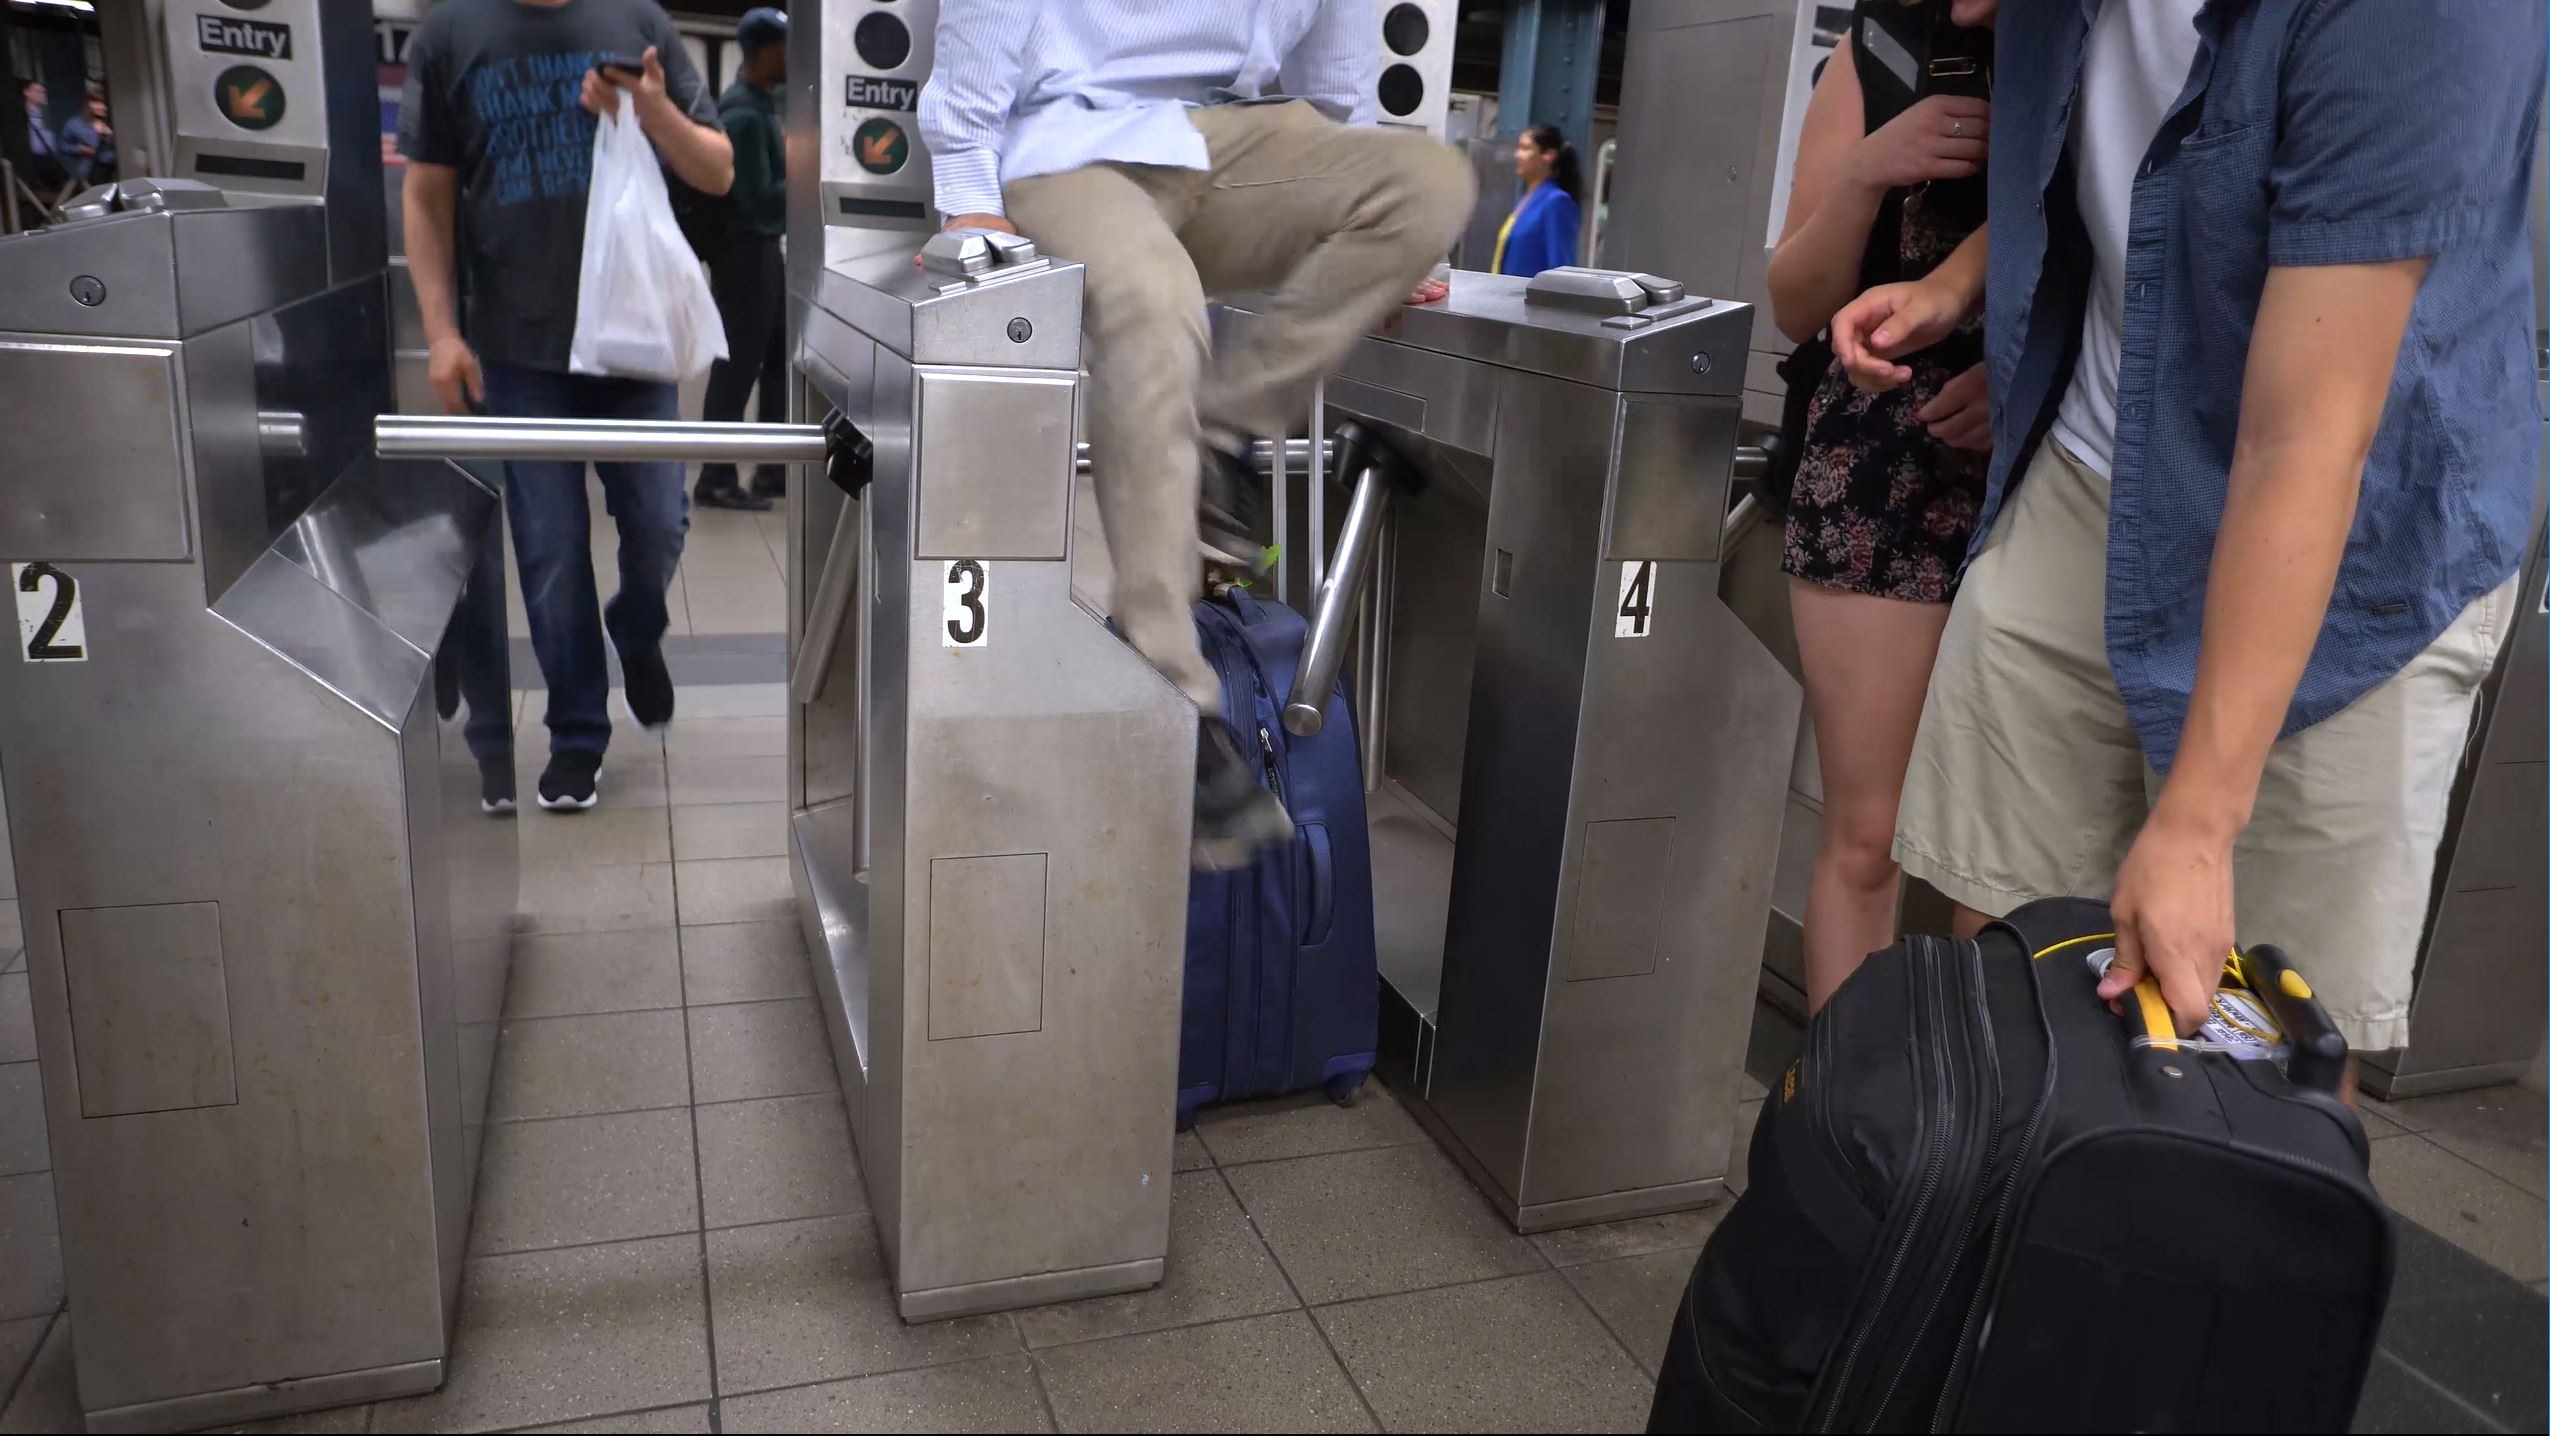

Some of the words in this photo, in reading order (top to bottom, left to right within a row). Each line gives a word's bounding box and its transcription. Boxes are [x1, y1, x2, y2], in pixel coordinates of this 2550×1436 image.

[200, 17, 286, 59] Entry
[848, 77, 915, 111] Entry
[19, 561, 83, 659] 2
[947, 559, 985, 643] 3
[1620, 560, 1651, 633] 4
